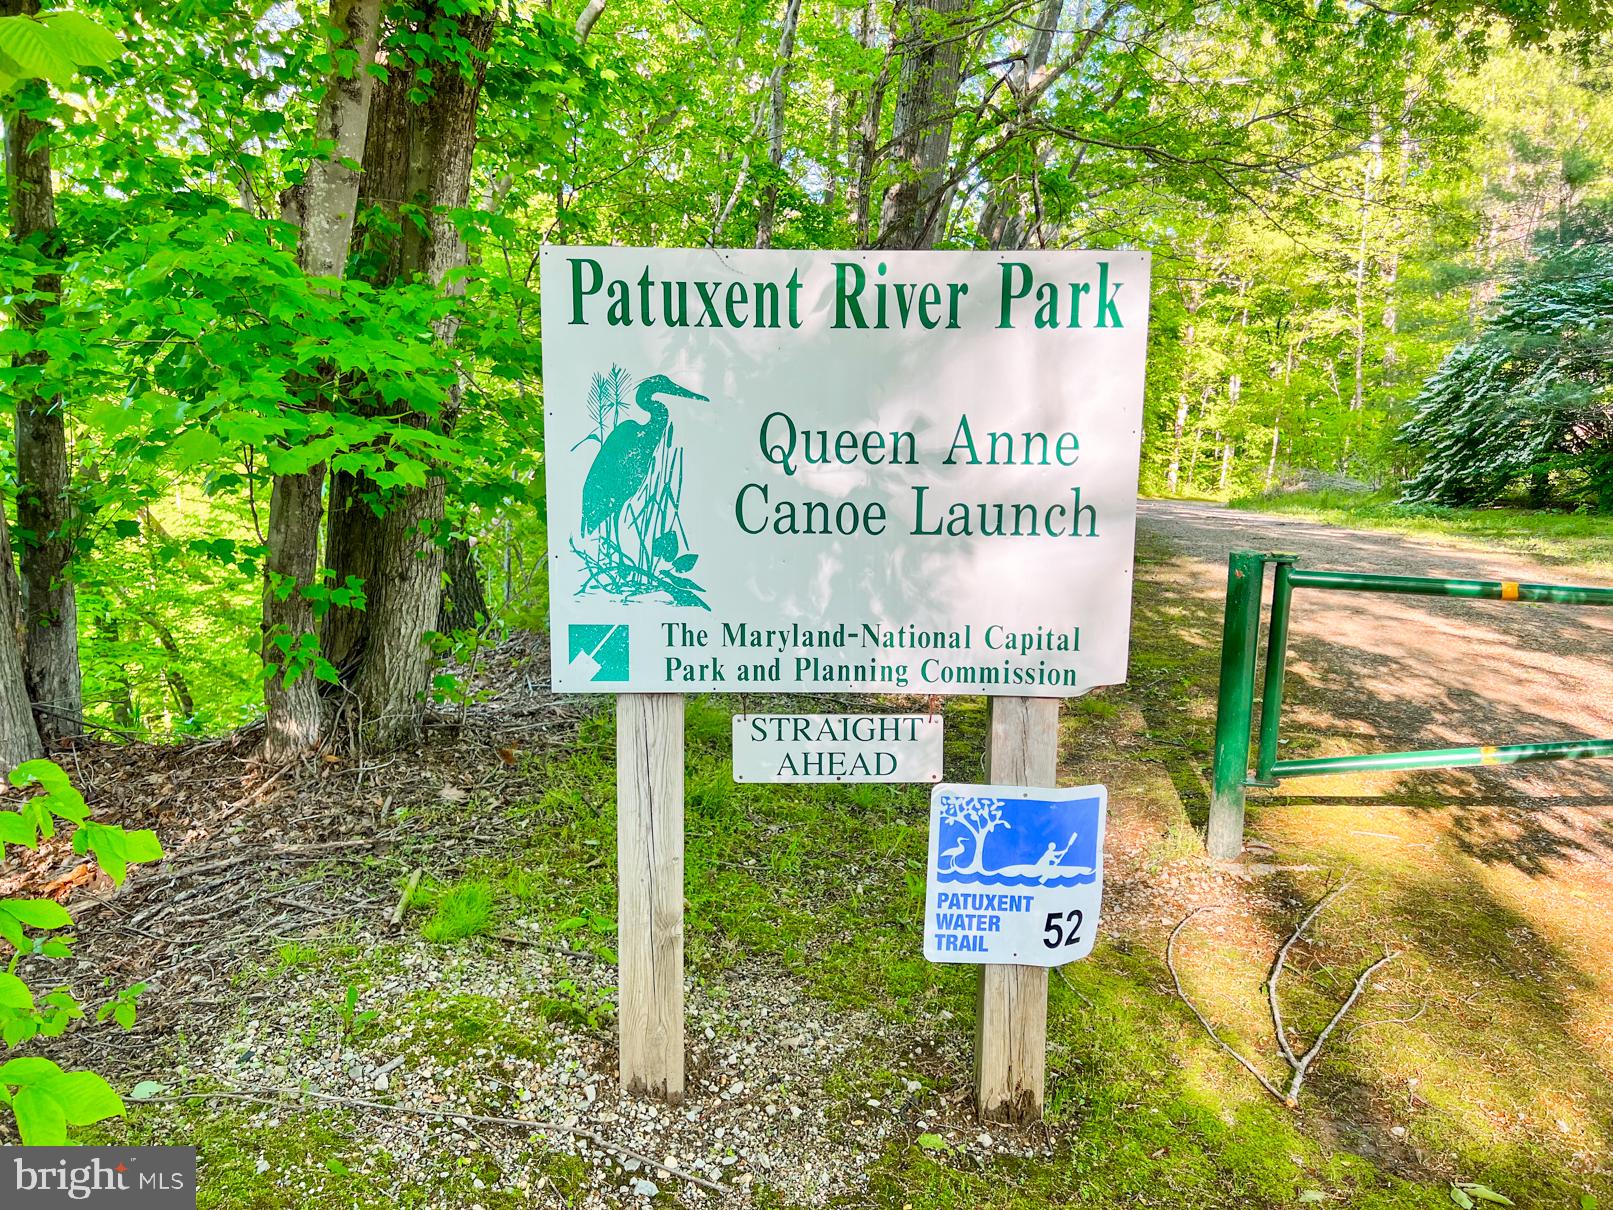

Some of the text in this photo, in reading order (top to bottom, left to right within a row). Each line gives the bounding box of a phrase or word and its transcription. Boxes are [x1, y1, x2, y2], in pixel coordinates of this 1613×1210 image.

[566, 258, 1125, 329] Patuxent River Park
[759, 411, 1080, 475] Queen Anne
[735, 483, 1100, 537] Canoe Launch
[661, 622, 1081, 655] The Maryland-National Capital
[665, 657, 1077, 687] Park and Planning Commission
[751, 716, 924, 742] STRAIGHT
[777, 751, 897, 776] AHEAD
[937, 892, 1034, 912] PATUXENT
[935, 913, 1000, 932] WATER
[1043, 909, 1083, 949] 52
[934, 934, 989, 952] TRAIL
